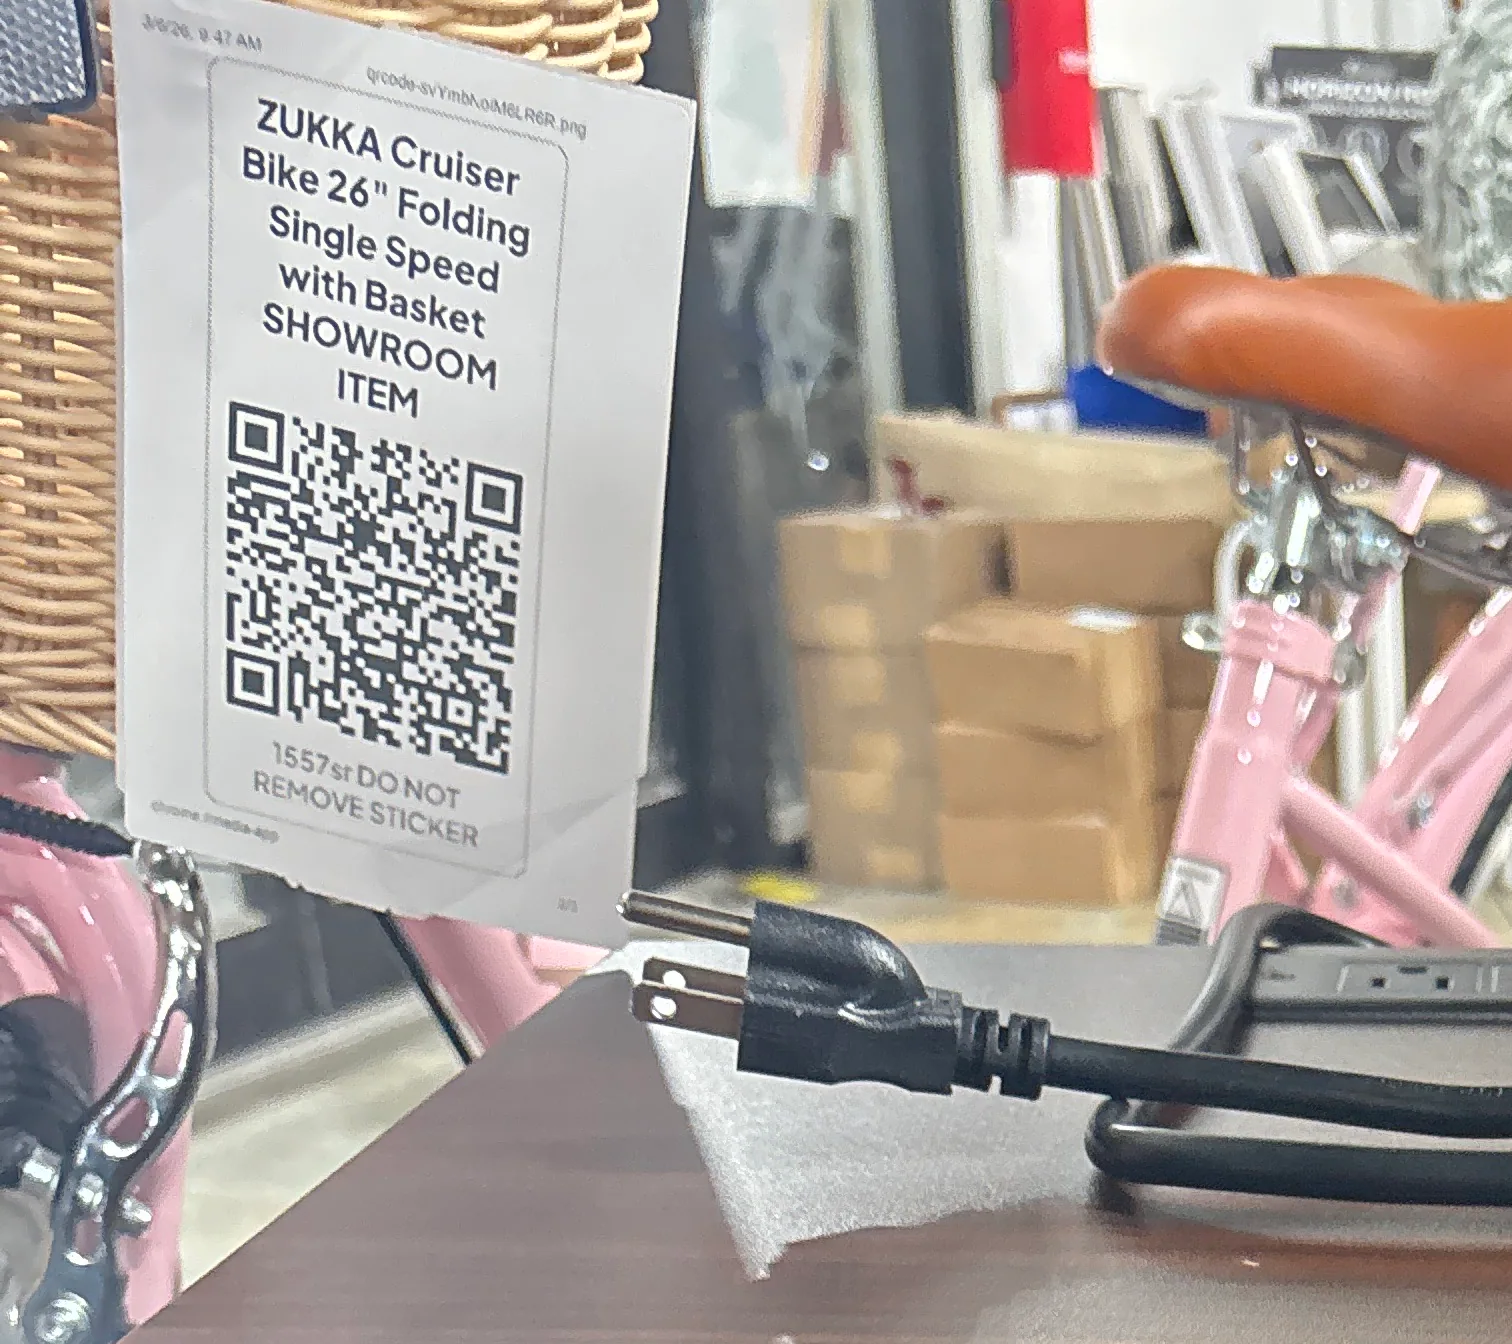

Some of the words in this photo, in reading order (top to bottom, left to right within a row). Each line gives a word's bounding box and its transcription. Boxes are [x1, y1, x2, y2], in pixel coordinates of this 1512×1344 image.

[236, 33, 262, 52] AM
[257, 98, 382, 162] ZUKKA
[391, 136, 521, 196] Cruiser
[242, 146, 319, 195] Bike
[327, 169, 388, 208] 26"
[398, 186, 530, 257] Folding
[269, 205, 377, 260] Single
[385, 235, 500, 294] Speed
[278, 263, 357, 306] with
[365, 279, 486, 339] Basket
[263, 303, 497, 391] SHOWROOM
[337, 368, 419, 418] ITEM
[253, 769, 364, 820] REMOVE
[370, 801, 479, 848] STICKER
[272, 741, 354, 782] 1557st
[357, 765, 399, 795] DO
[404, 775, 461, 809] NOT
